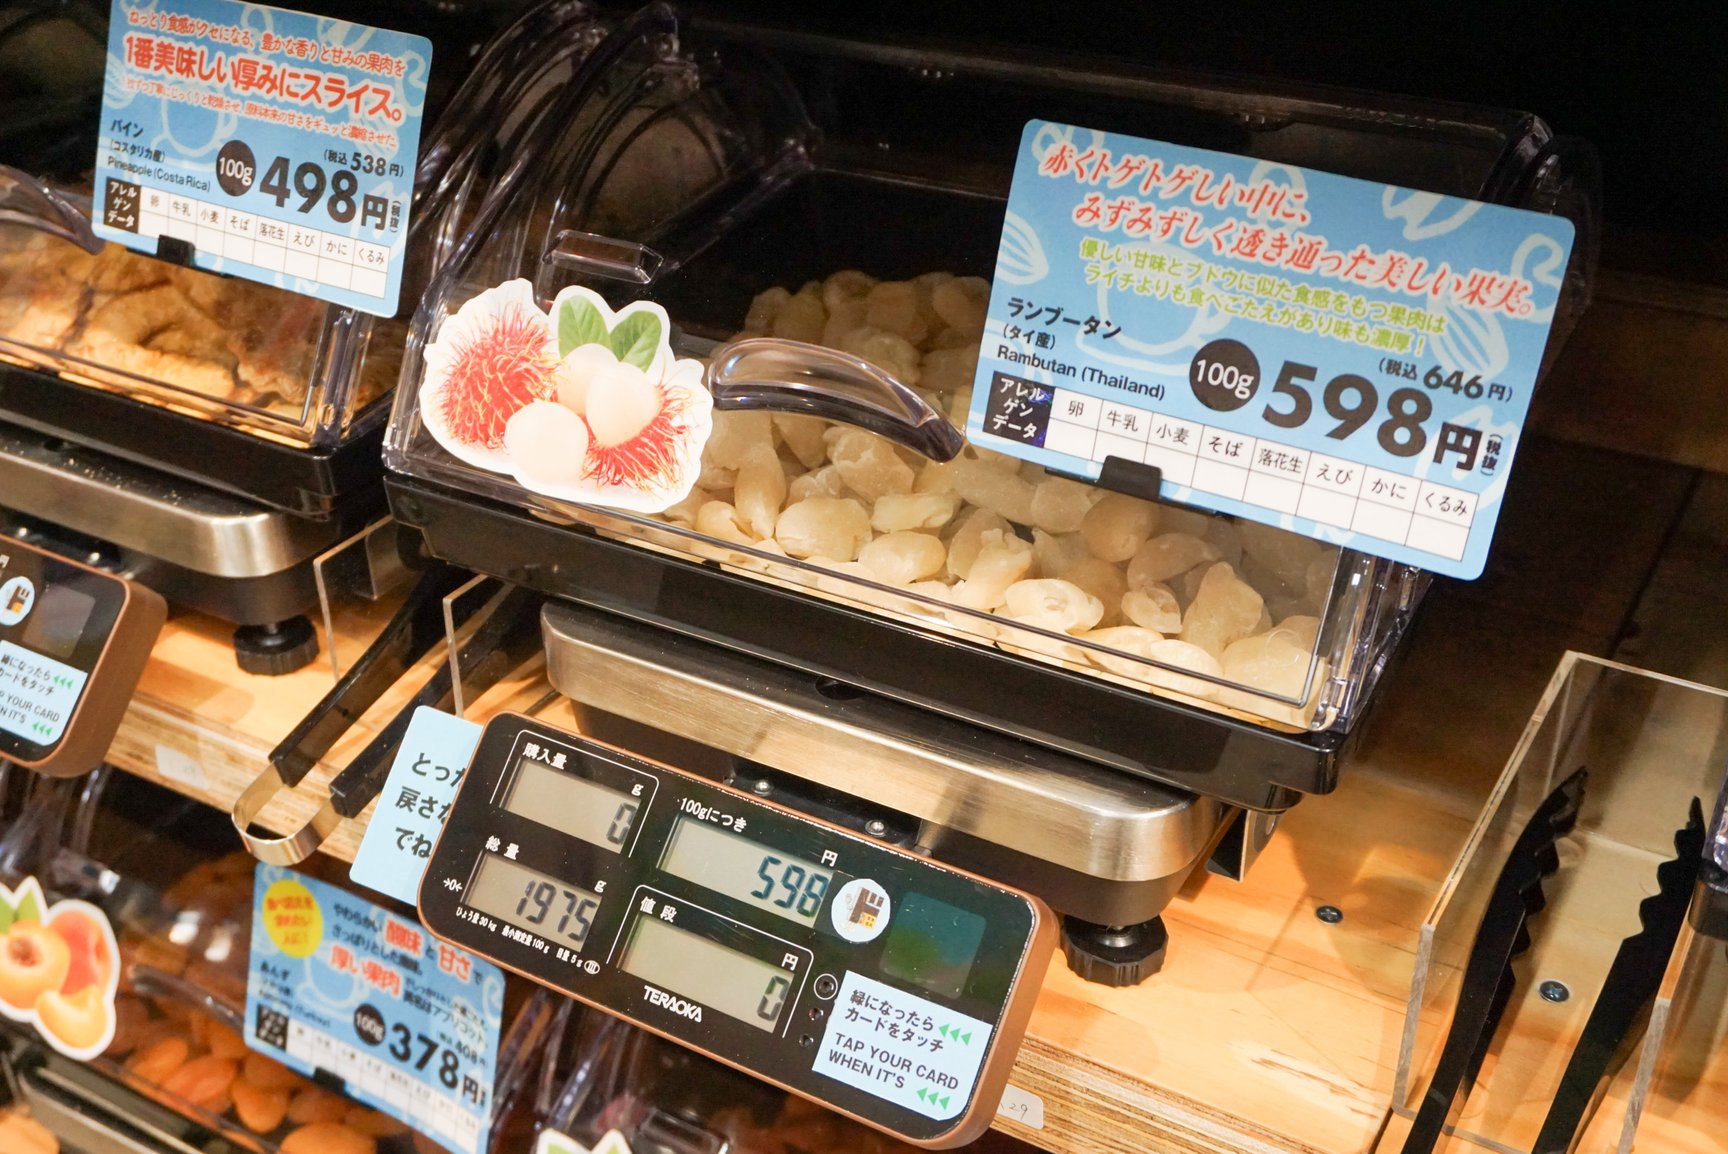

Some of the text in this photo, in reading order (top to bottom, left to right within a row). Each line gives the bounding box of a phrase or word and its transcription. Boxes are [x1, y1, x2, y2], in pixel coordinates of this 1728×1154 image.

[124, 35, 402, 122] 1番美味しい厚みにスライス。
[108, 155, 211, 192] Pineapple (Costa Rica)
[218, 157, 253, 186] 100g
[1044, 144, 1307, 223] 赤くトゲトゲしい中に、
[109, 181, 137, 199] アレル
[113, 197, 132, 211] ゲン
[172, 201, 191, 217] 牛乳
[200, 208, 220, 225] 小麦
[107, 210, 135, 228] データ
[230, 215, 250, 231] そば
[259, 222, 285, 241] 落花生
[292, 231, 314, 247] えび
[325, 240, 347, 256] かに
[358, 247, 385, 265] くるみ
[1075, 195, 1532, 315] みずみずしく透き通った美しい果実。
[1080, 238, 1446, 333] 優しい甘味とブドウに似た食感をもつ果肉は
[1007, 297, 1122, 339] ランブータン
[1003, 324, 1056, 350] (タイ産)
[997, 345, 1166, 401] Rambutan (Thailand)
[1196, 358, 1255, 399] 100g
[1000, 377, 1045, 401] アレル
[1003, 399, 1034, 417] ゲン
[1067, 400, 1085, 417] 卵
[1106, 409, 1139, 431] 牛乳
[992, 413, 1038, 439] データ
[1156, 422, 1190, 446] 小麦
[1208, 435, 1243, 458] そば
[1257, 448, 1304, 473] 落花生
[1316, 463, 1354, 485] えび
[1372, 477, 1408, 500] かに
[1424, 491, 1468, 516] くるみ
[7, 693, 32, 712] YOUR
[34, 704, 60, 723] CARD
[522, 742, 568, 770] 購入量
[631, 784, 644, 796] g
[606, 802, 638, 845] 0
[680, 797, 747, 833] 100gにつき
[820, 849, 838, 867] 円
[594, 880, 607, 893] g
[750, 855, 830, 918] 598
[515, 879, 598, 943] 1975
[781, 953, 799, 971] 円
[643, 985, 702, 1023] TERAOKA
[756, 975, 790, 1021] 0
[850, 989, 935, 1032] 緑になったら
[354, 1010, 385, 1042] 100g
[844, 1007, 944, 1053] カードをタッチ
[828, 1049, 905, 1089] WHEN IT'S
[834, 1032, 959, 1090] TAP YOUR CARD
